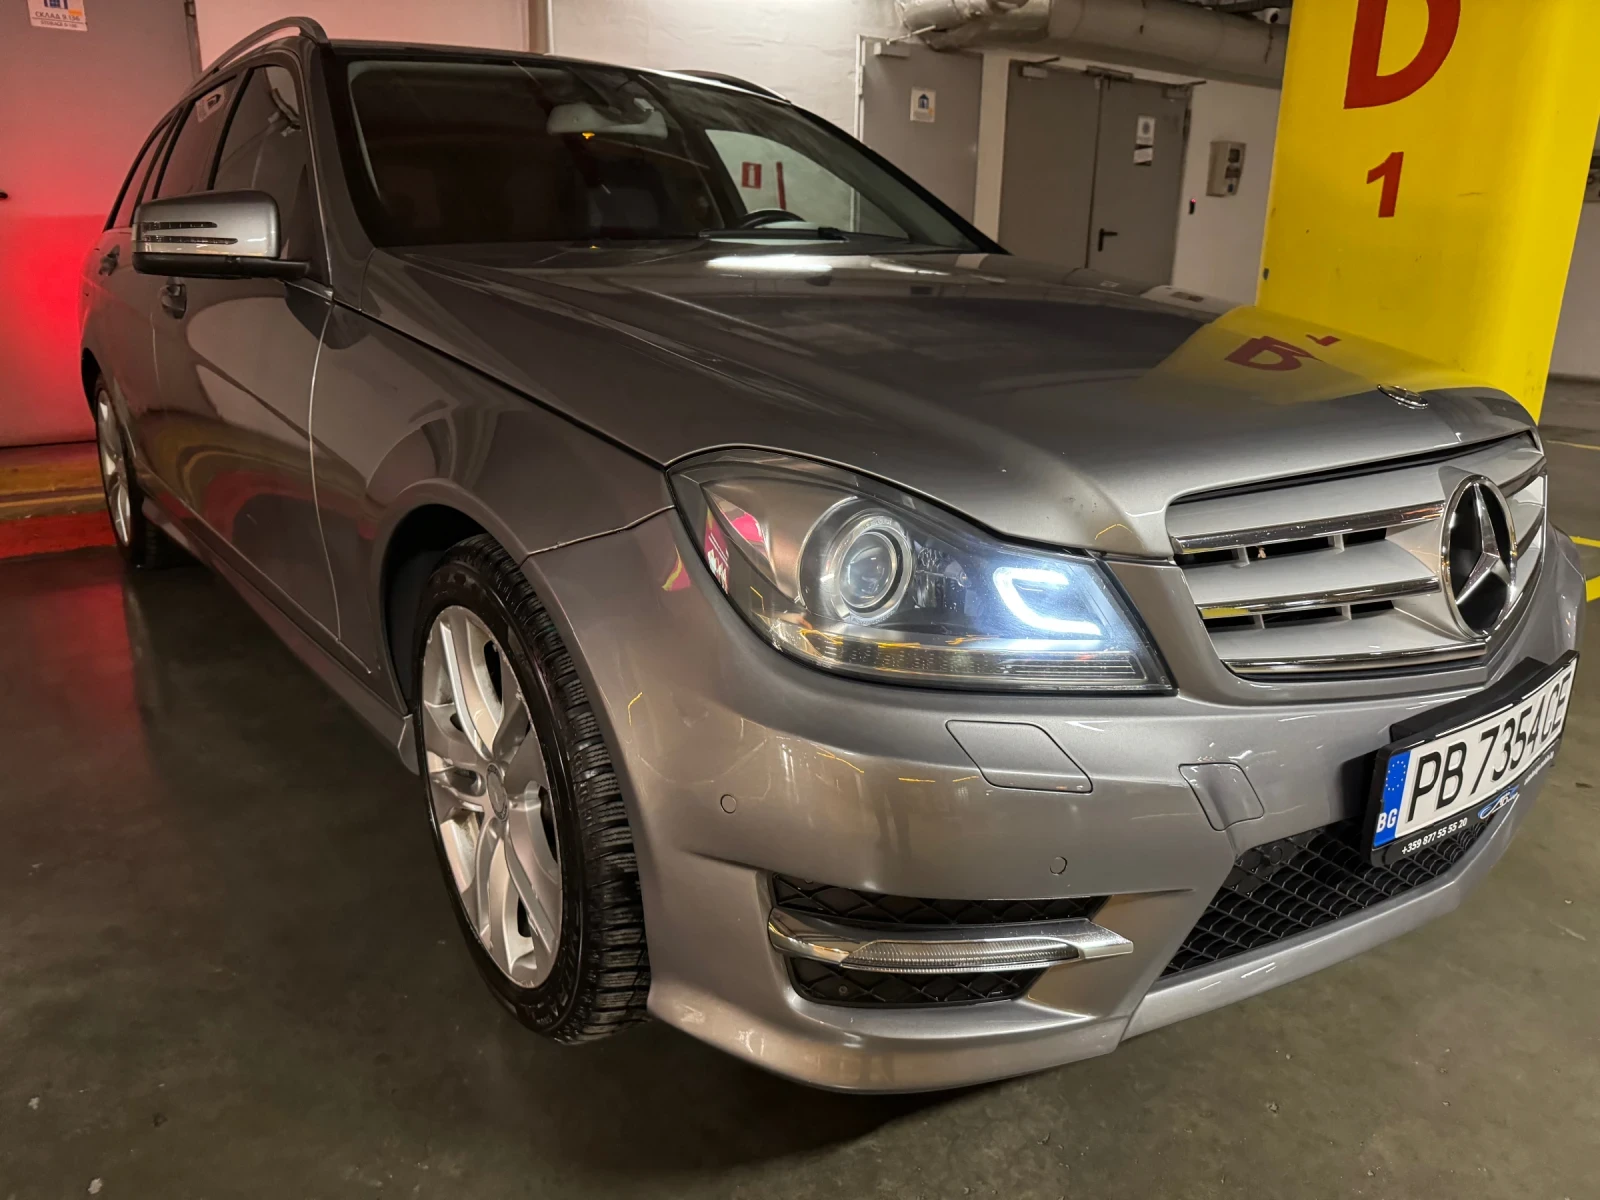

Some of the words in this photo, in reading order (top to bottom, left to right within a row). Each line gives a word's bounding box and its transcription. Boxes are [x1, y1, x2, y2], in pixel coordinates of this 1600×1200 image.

[1343, 0, 1461, 109] D
[1366, 151, 1404, 218] 1
[1407, 741, 1468, 822] PB
[1376, 808, 1398, 833] BG
[1401, 838, 1422, 855] +359
[1422, 831, 1437, 845] 877
[1436, 826, 1448, 839] 55
[1447, 821, 1458, 834] 55
[1457, 817, 1468, 829] 20
